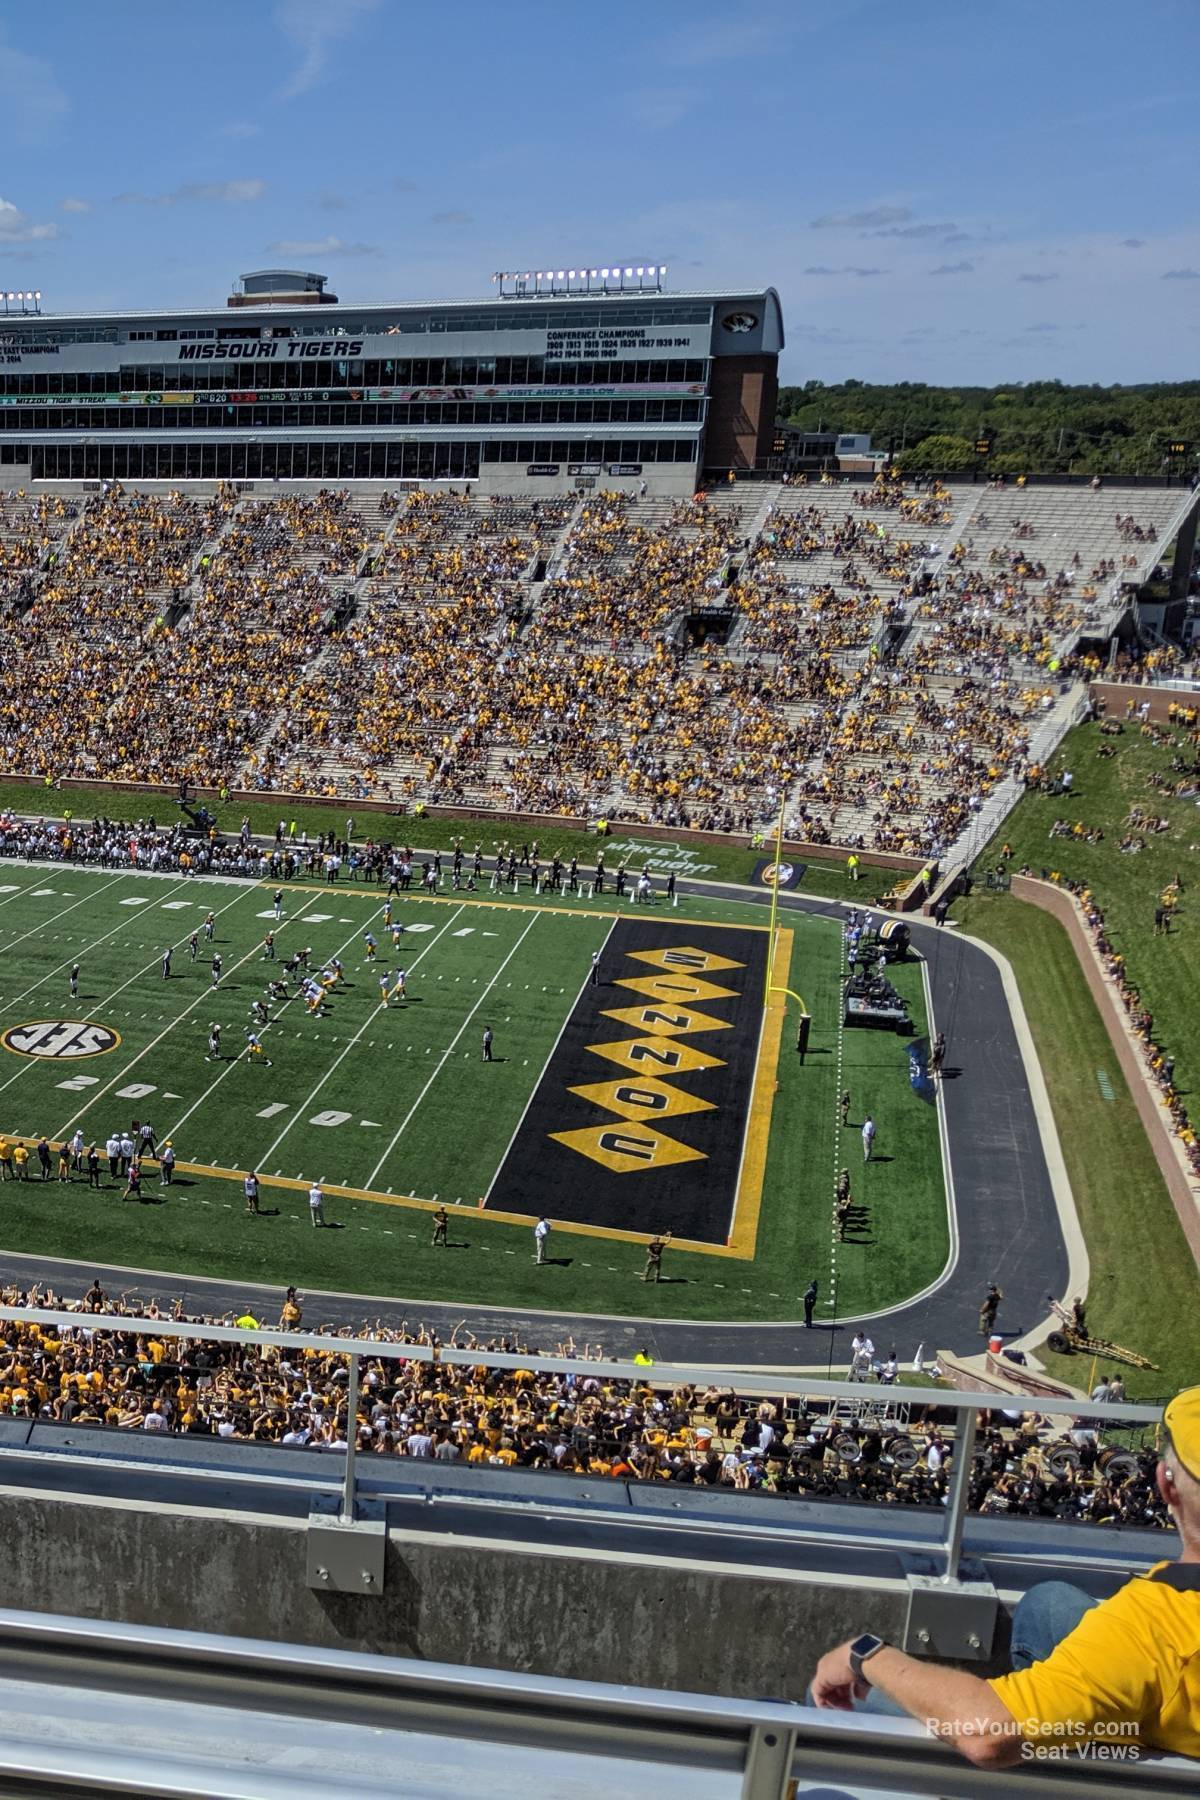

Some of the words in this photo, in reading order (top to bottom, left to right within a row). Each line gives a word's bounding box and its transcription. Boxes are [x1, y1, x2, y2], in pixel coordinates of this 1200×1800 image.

[547, 331, 596, 340] CONFERENCE
[599, 330, 646, 339] CHAMPIONS
[21, 345, 59, 353] CHAMPIONS
[179, 342, 278, 359] MISSOURI
[288, 341, 364, 356] TIGERS
[638, 339, 655, 348] 1927
[323, 392, 329, 400] 0
[605, 842, 669, 856] MAKE
[643, 858, 718, 873] RIGHT
[10, 1022, 115, 1056] SEC
[598, 950, 708, 1161] MIZZOU
